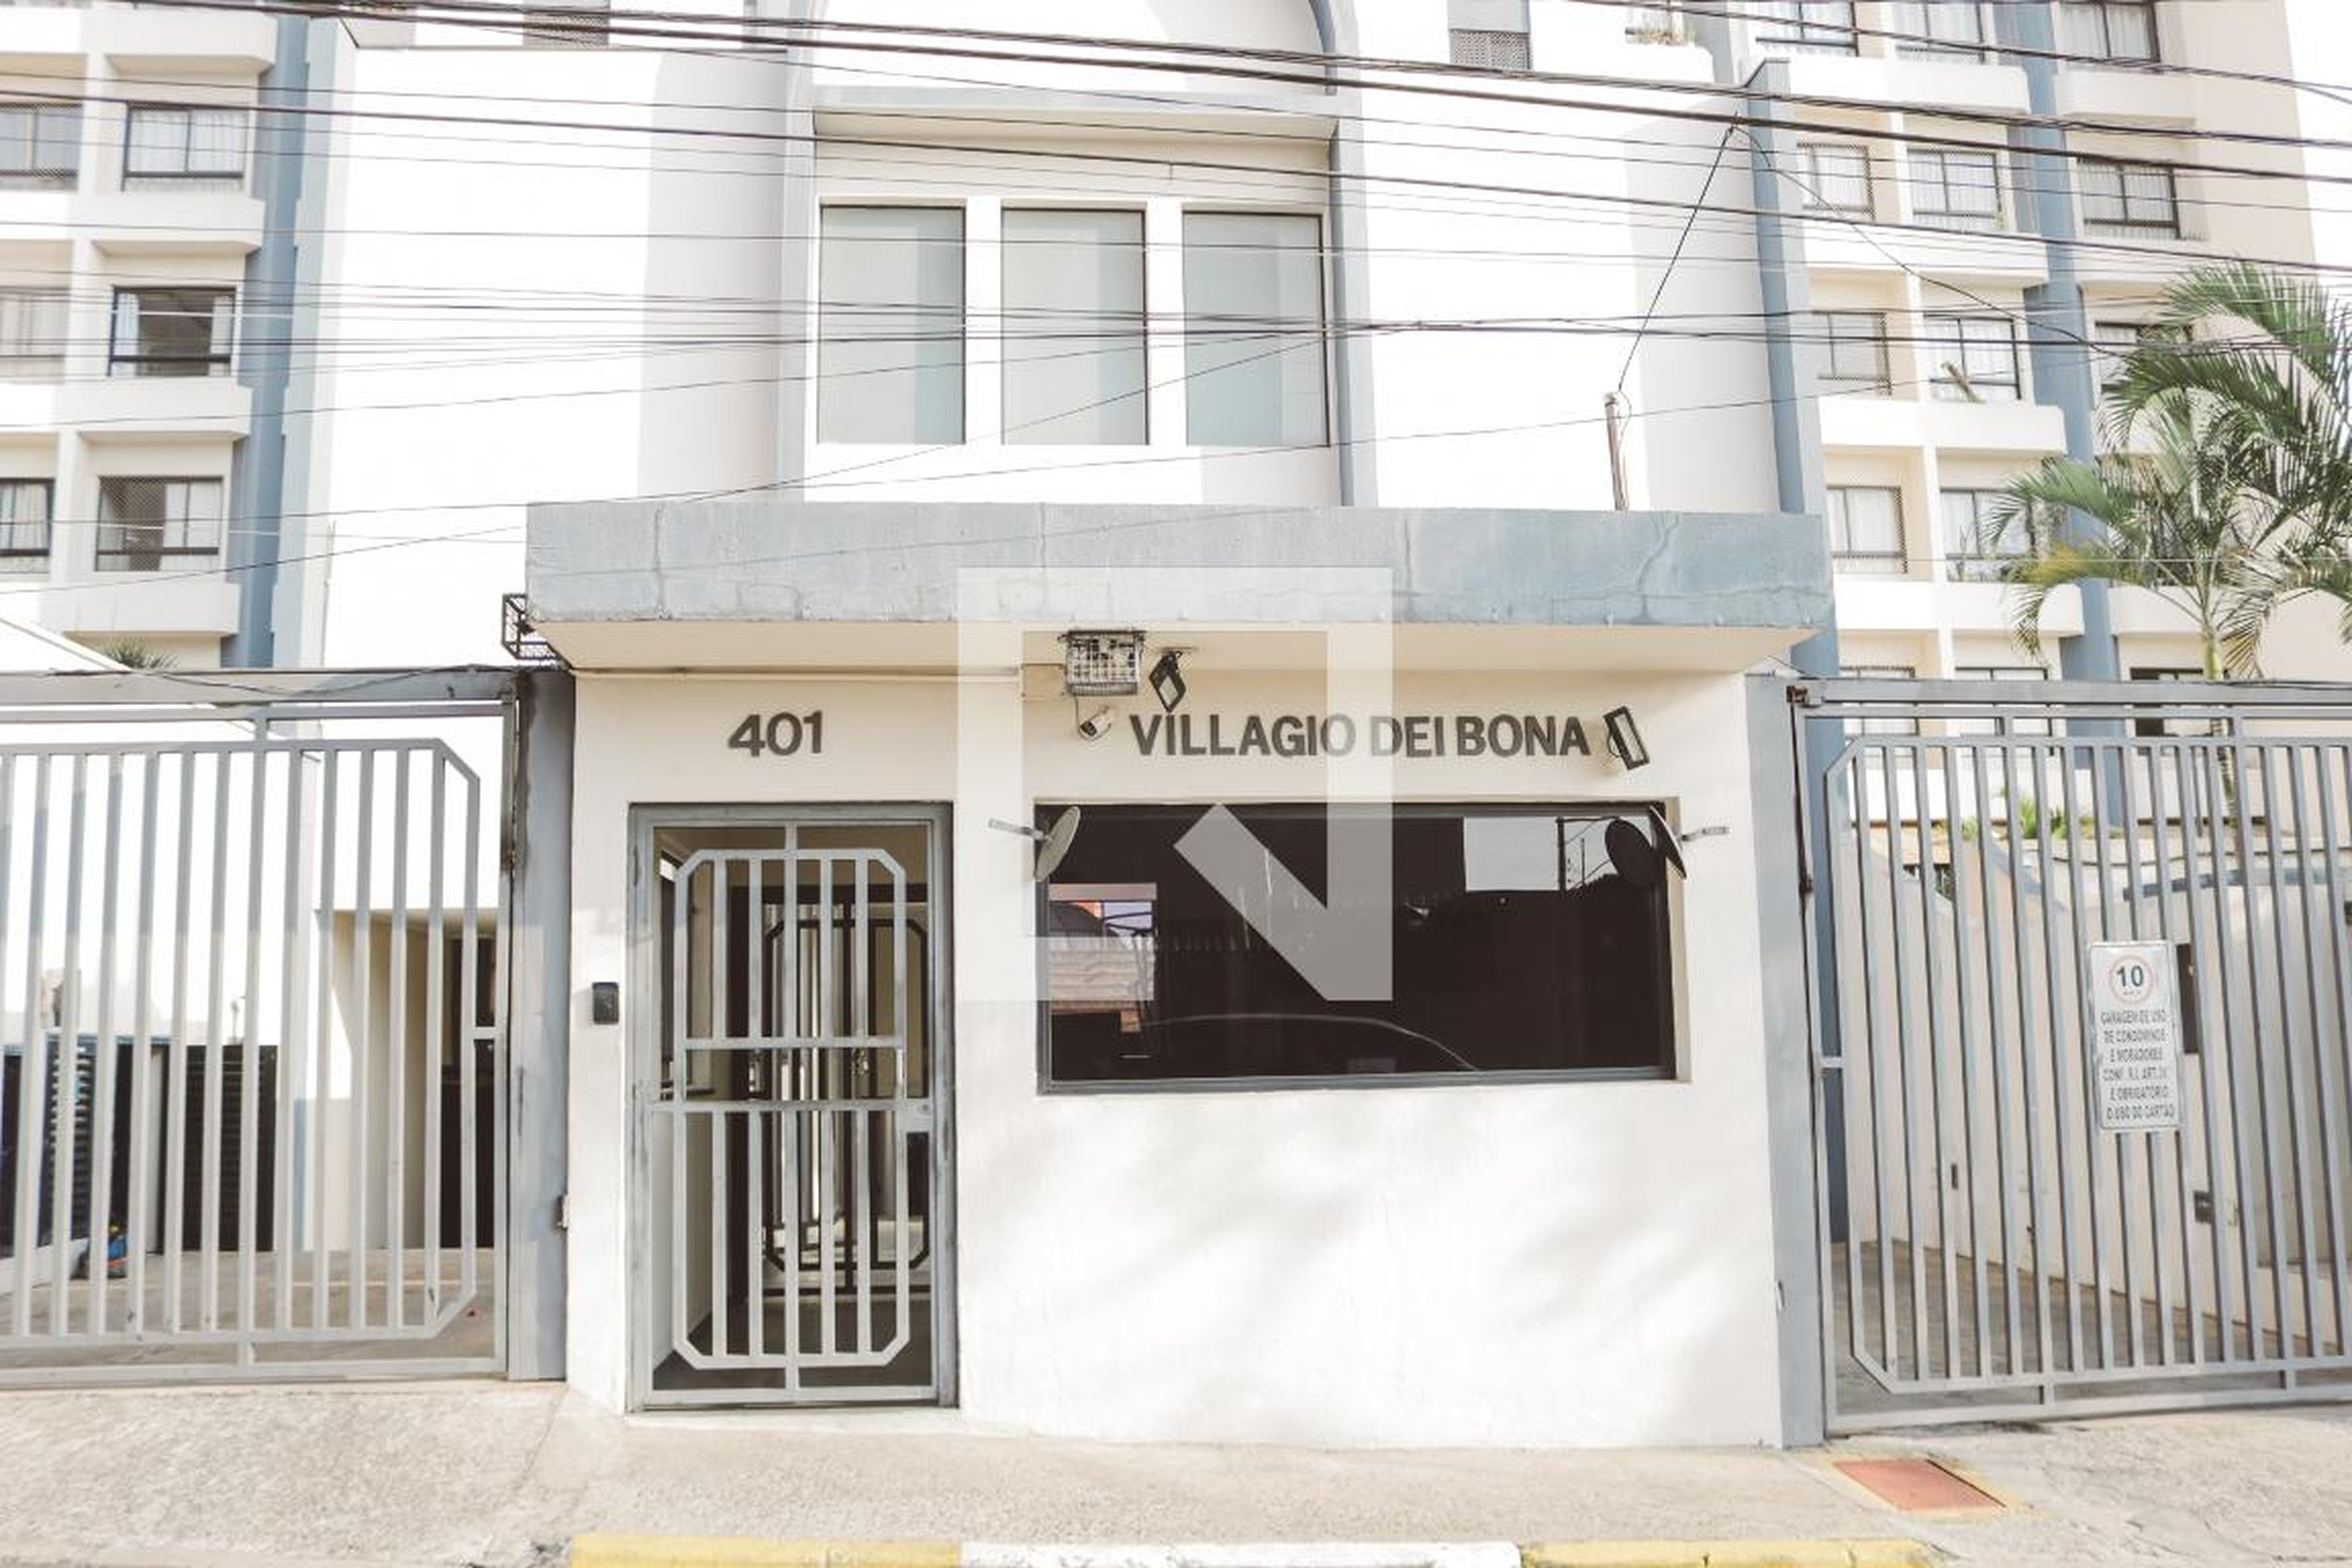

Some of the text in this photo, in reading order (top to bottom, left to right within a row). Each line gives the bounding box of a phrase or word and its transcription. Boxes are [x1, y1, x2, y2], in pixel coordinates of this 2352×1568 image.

[728, 710, 823, 758] 401
[1128, 713, 1591, 758] VILLAGIO DEI BONA
[2116, 965, 2144, 987] 10
[2104, 1030, 2114, 1044] DE
